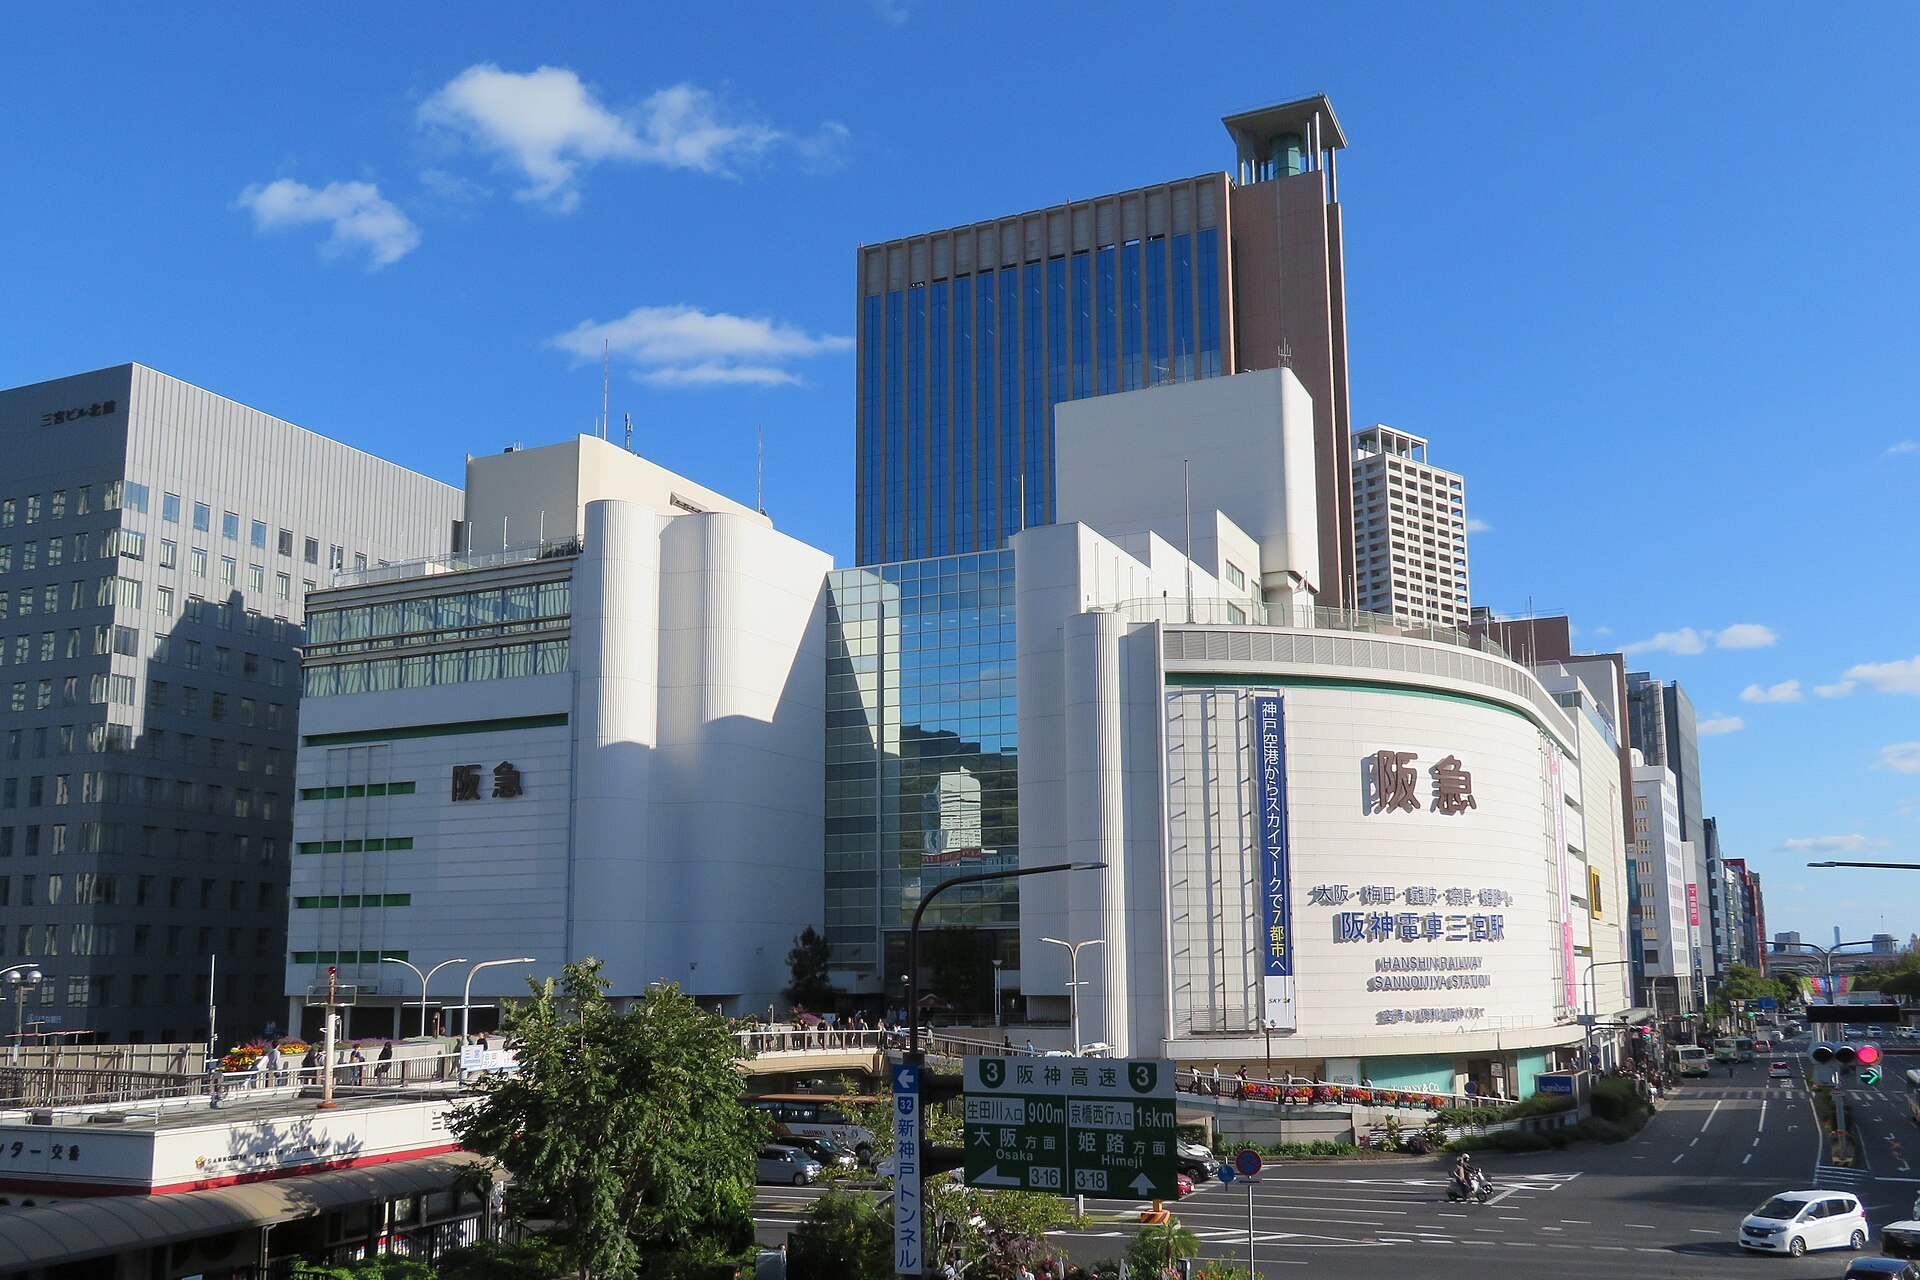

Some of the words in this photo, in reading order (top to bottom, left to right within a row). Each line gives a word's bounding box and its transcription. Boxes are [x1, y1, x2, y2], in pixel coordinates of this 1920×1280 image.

[41, 400, 116, 427] 三宮ビル北館
[451, 761, 523, 802] 阪急
[1377, 750, 1477, 814] 阪急
[1262, 701, 1286, 971] 神戸空港からスカイマークで7都市へ
[1340, 911, 1504, 940] 阪神電車三宮駅
[1383, 957, 1437, 969] HANSHIN
[1440, 956, 1483, 969] RAILWAY
[1375, 976, 1447, 989] SANNOMIYA
[1452, 974, 1491, 988] STATION
[986, 1062, 999, 1082] 3
[1016, 1065, 1117, 1087] 阪神高速
[1136, 1066, 1150, 1086] 3
[900, 1100, 912, 1110] 32
[967, 1100, 1023, 1121] 生田川入口
[1028, 1102, 1064, 1123] 900m
[1070, 1103, 1132, 1126] 京橋西行入口
[1136, 1106, 1175, 1128] 1.5km
[995, 1148, 1034, 1161] Osaka
[1100, 1154, 1143, 1169] Himeji
[1031, 1168, 1059, 1186] 3-16
[1076, 1171, 1105, 1189] 3-18
[898, 1118, 917, 1269] 新神戸トンネル
